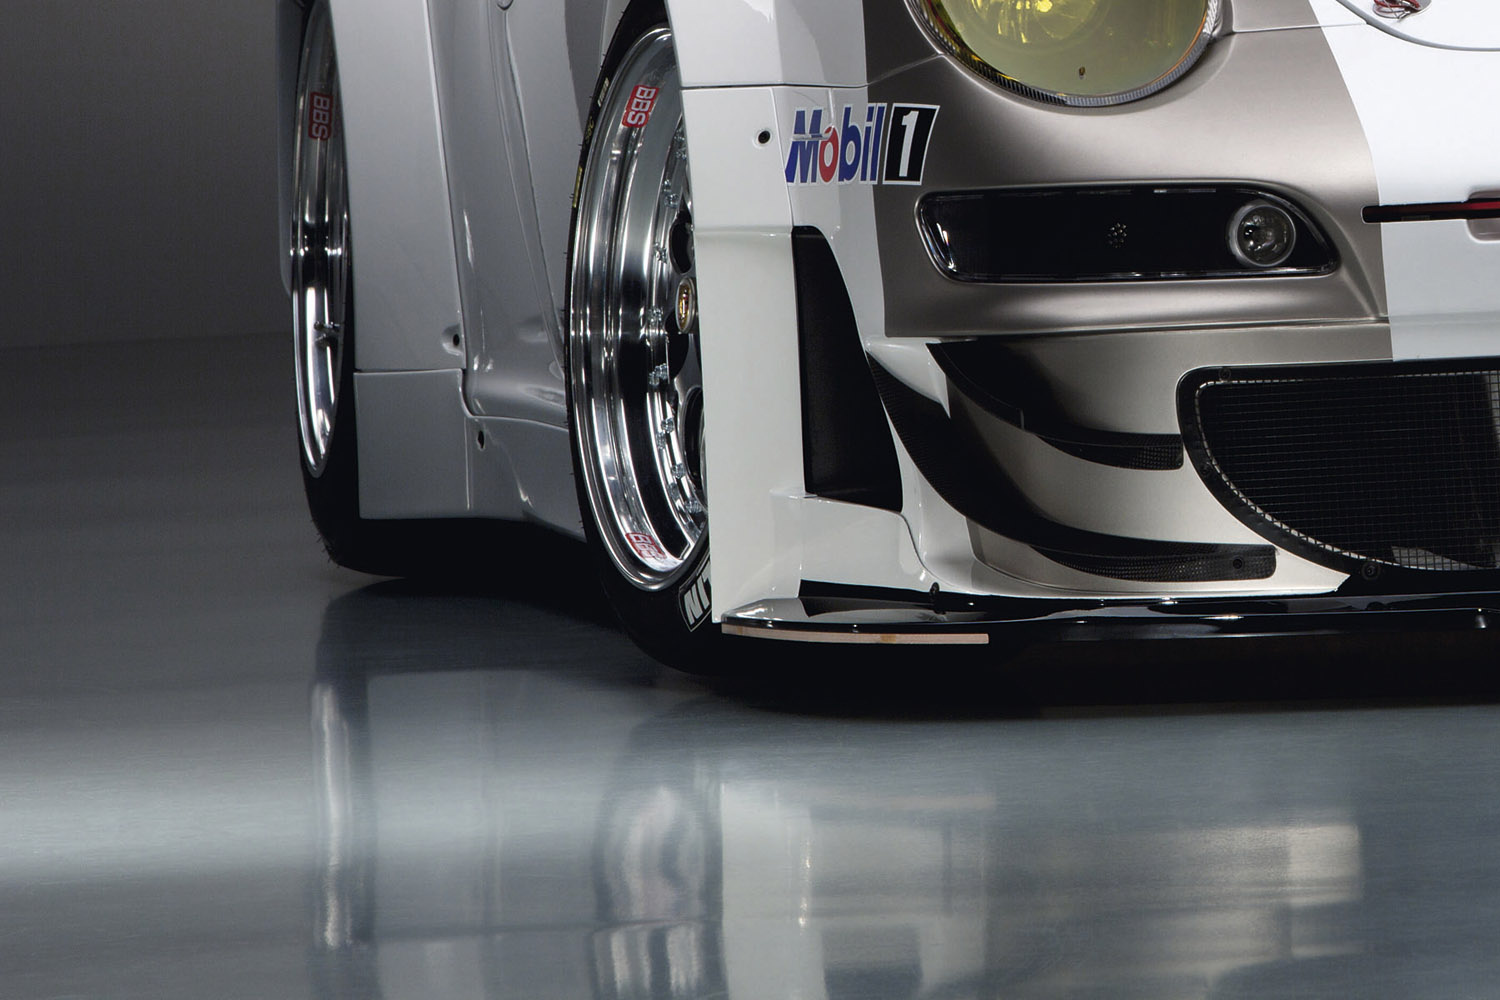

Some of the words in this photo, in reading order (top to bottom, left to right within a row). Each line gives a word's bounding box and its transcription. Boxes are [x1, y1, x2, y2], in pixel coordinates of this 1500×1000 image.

[312, 95, 330, 139] BBS
[626, 85, 657, 126] BBS
[785, 104, 886, 184] Mobil
